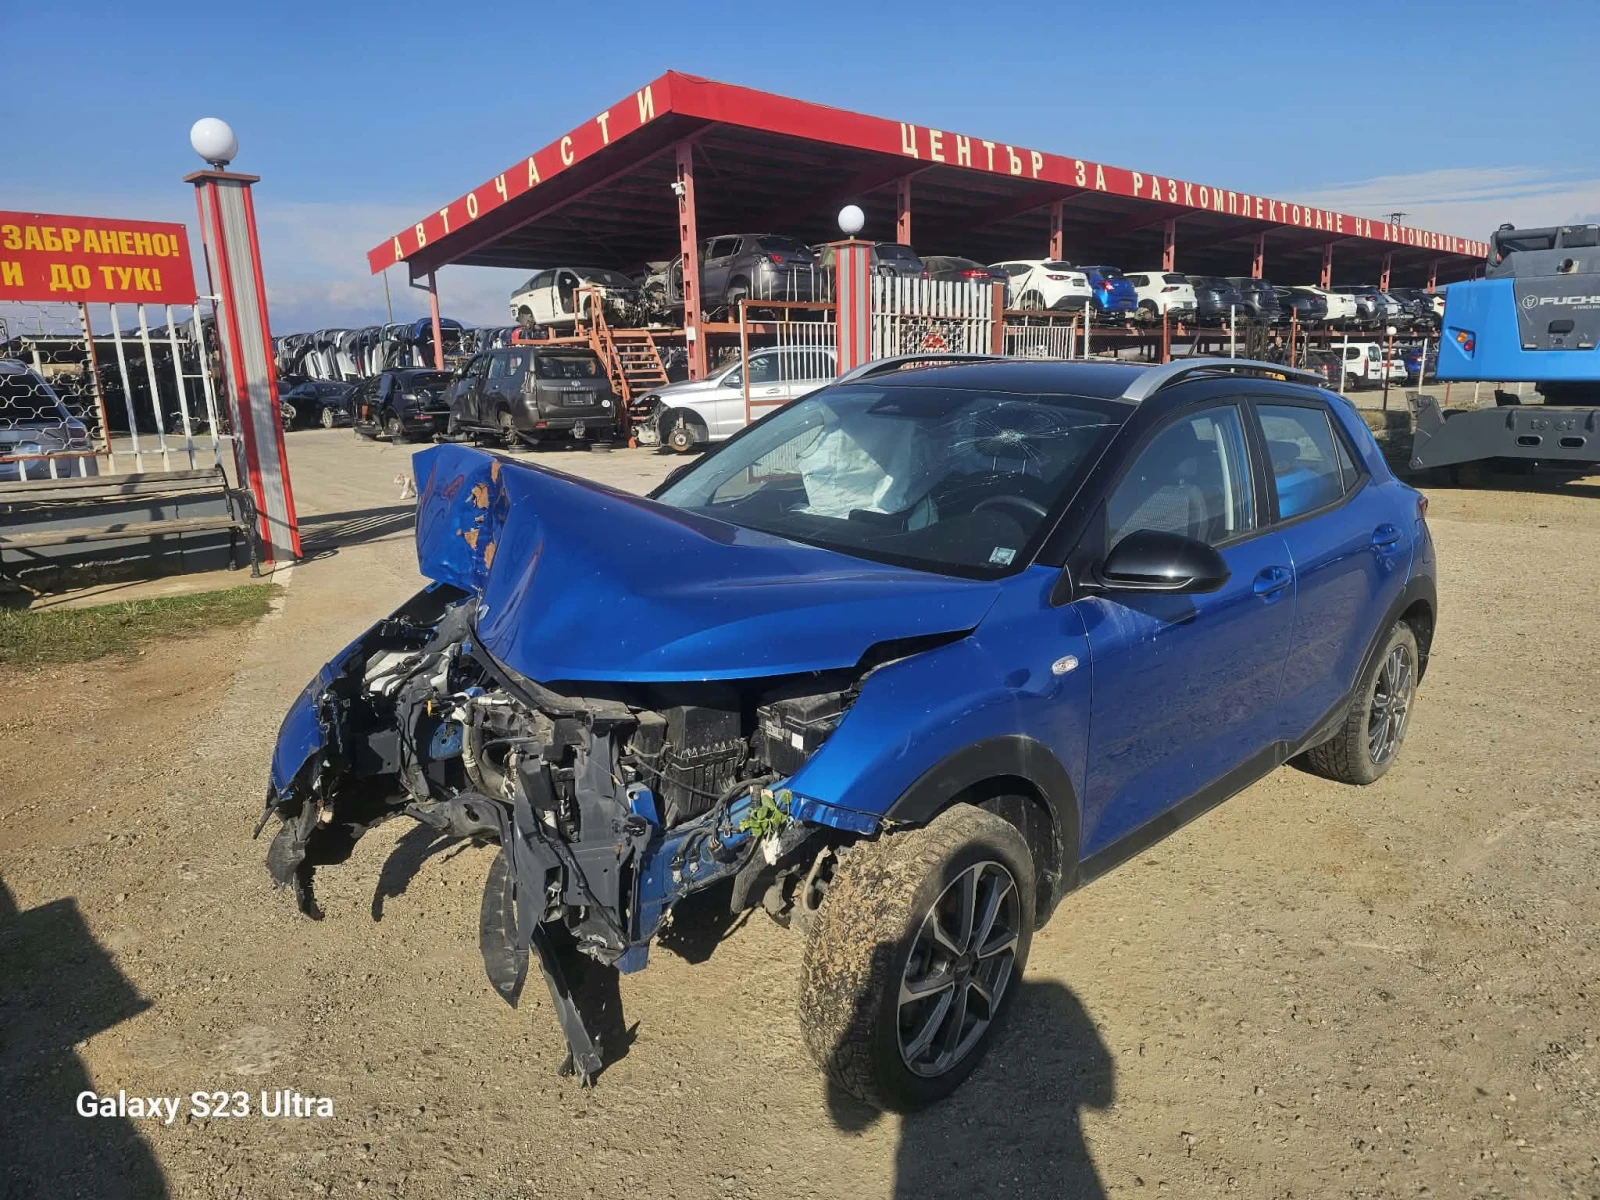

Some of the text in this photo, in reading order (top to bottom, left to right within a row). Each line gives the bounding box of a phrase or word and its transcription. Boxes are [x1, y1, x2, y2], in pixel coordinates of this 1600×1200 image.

[394, 85, 654, 261] АВТОЧАСТИ
[901, 122, 1043, 179] ЦЕНТЪР
[1075, 160, 1106, 192] ЗА
[1132, 171, 1343, 233] РАЗКОМПЛЕКТОВАНЕ
[1355, 217, 1372, 238] НА
[1, 224, 180, 257] ЗАБРАНЕНО!
[1, 261, 162, 292] И ДО ТУК!
